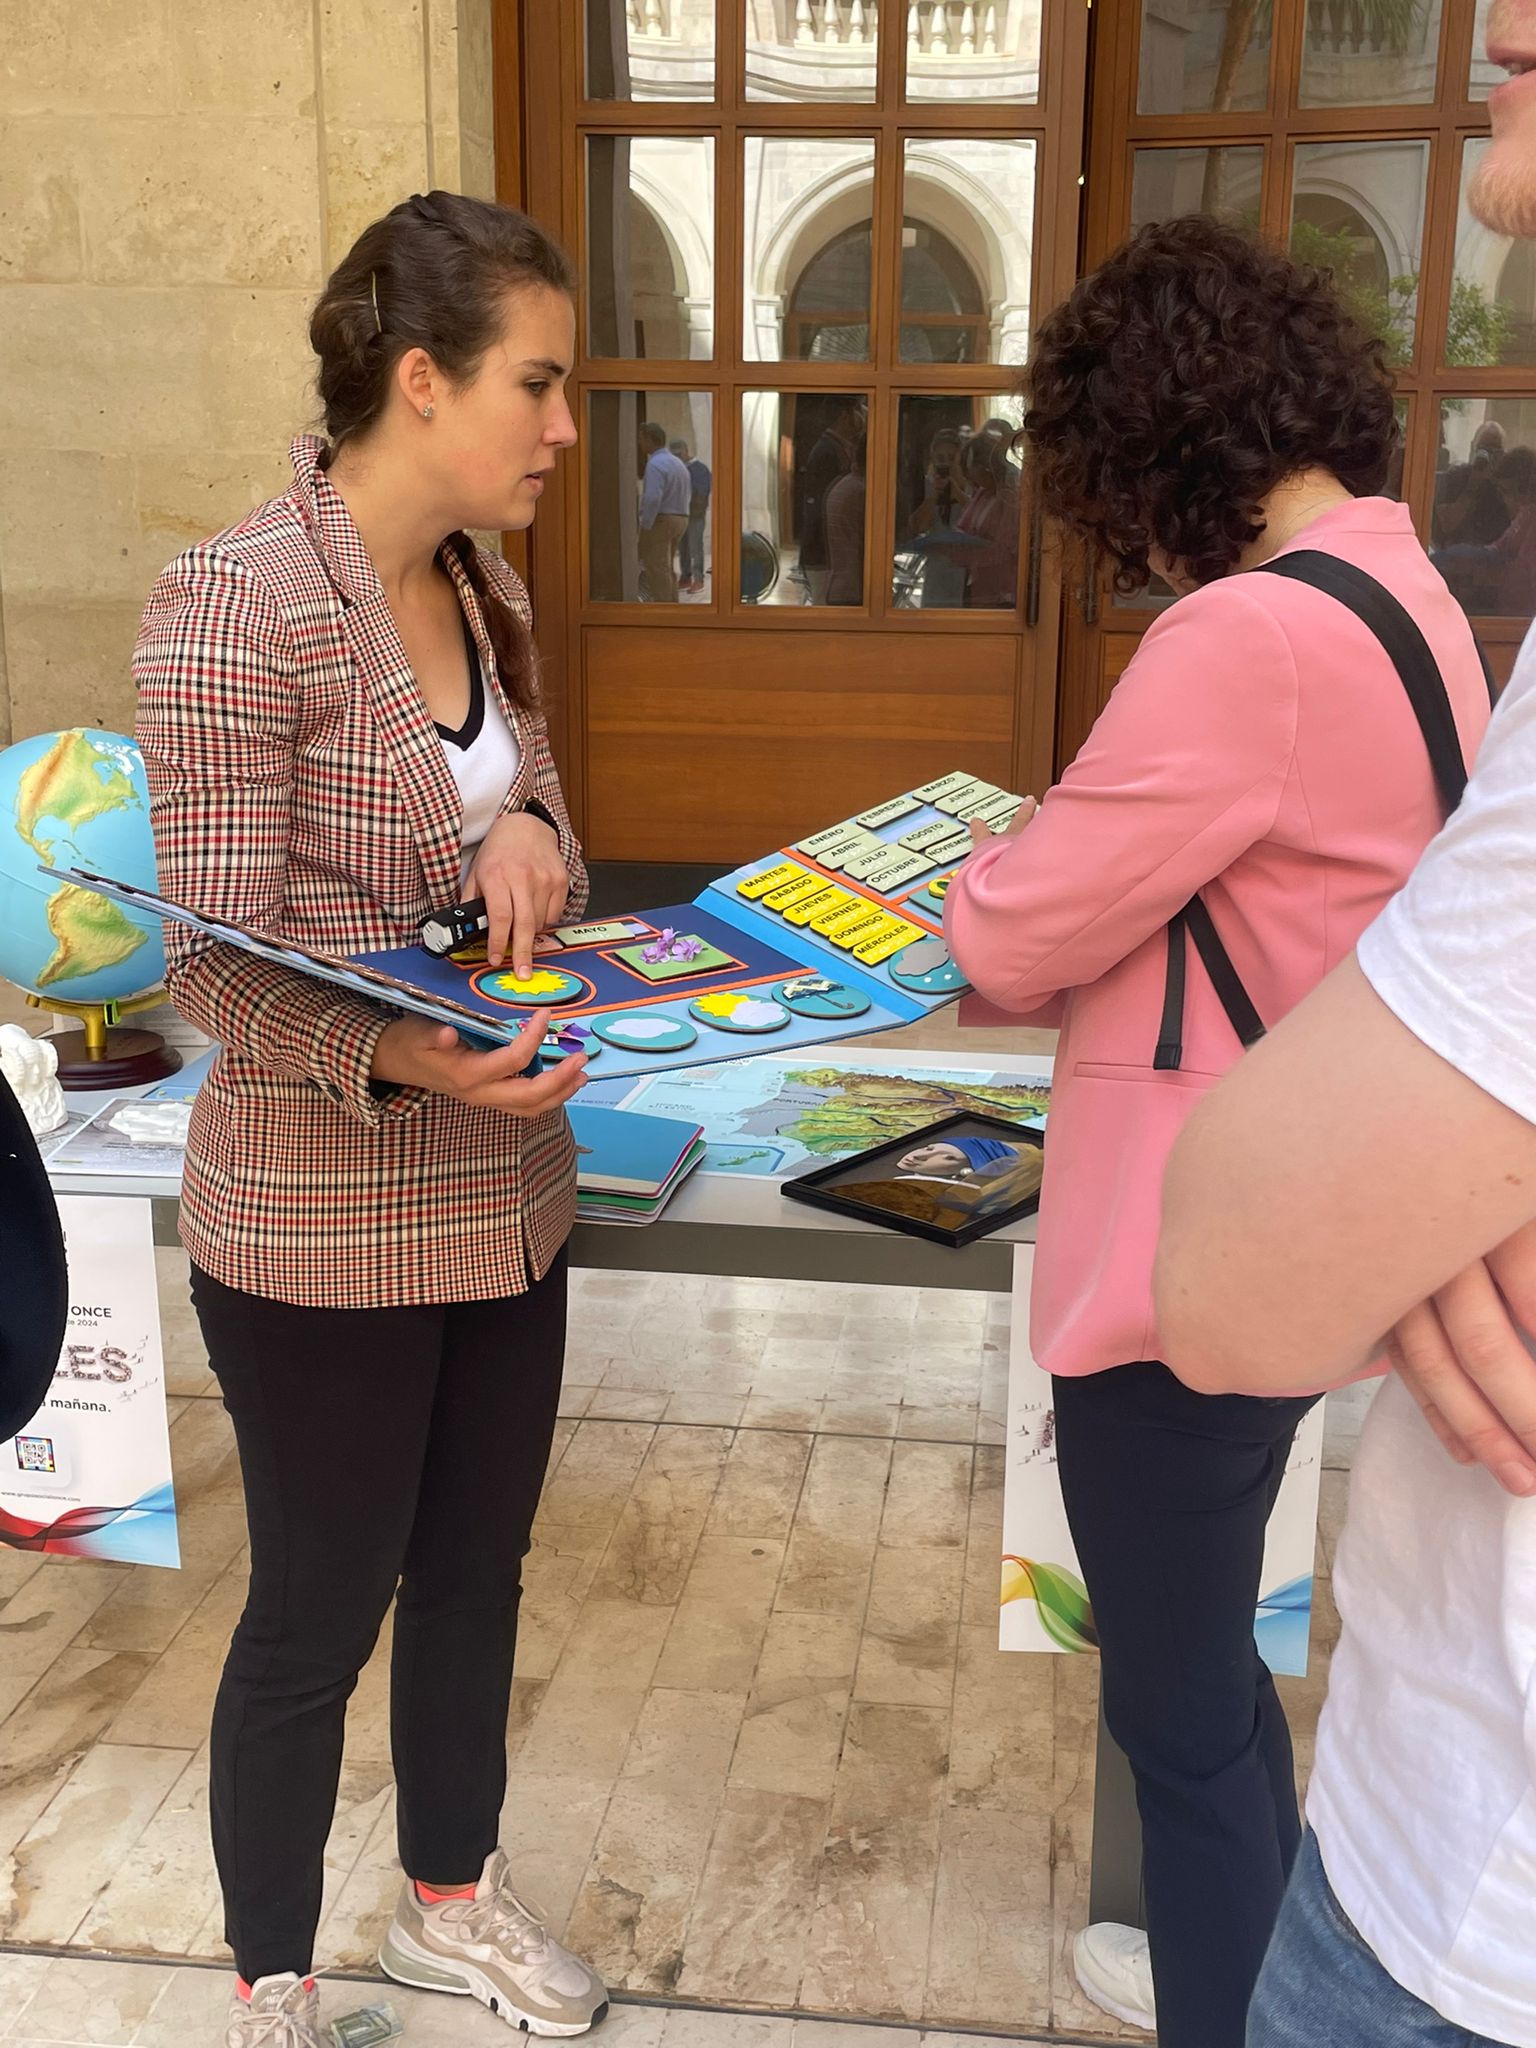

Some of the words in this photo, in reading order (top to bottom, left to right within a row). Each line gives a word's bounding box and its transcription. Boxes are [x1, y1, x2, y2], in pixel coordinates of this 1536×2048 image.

[922, 777, 956, 793] MARZO
[948, 788, 975, 803] JUNIO
[860, 799, 905, 822] FEBRERO
[960, 794, 1008, 819] SEPTIEMBRE
[808, 828, 845, 846] ENERO
[906, 823, 944, 842] AGOSTO
[830, 841, 862, 857] ABRIL
[859, 850, 888, 866] JULIO
[745, 867, 788, 888] MARTES
[871, 857, 919, 883] OCTUBRE
[794, 893, 833, 914] JUEVES
[816, 902, 862, 925] VIERNES
[573, 926, 607, 934] MAYO
[834, 915, 883, 940] DOMINGO
[71, 1306, 112, 1318] ONCE
[77, 1319, 98, 1327] 2024
[55, 1345, 132, 1382] ES
[51, 1398, 111, 1412] mañana.
